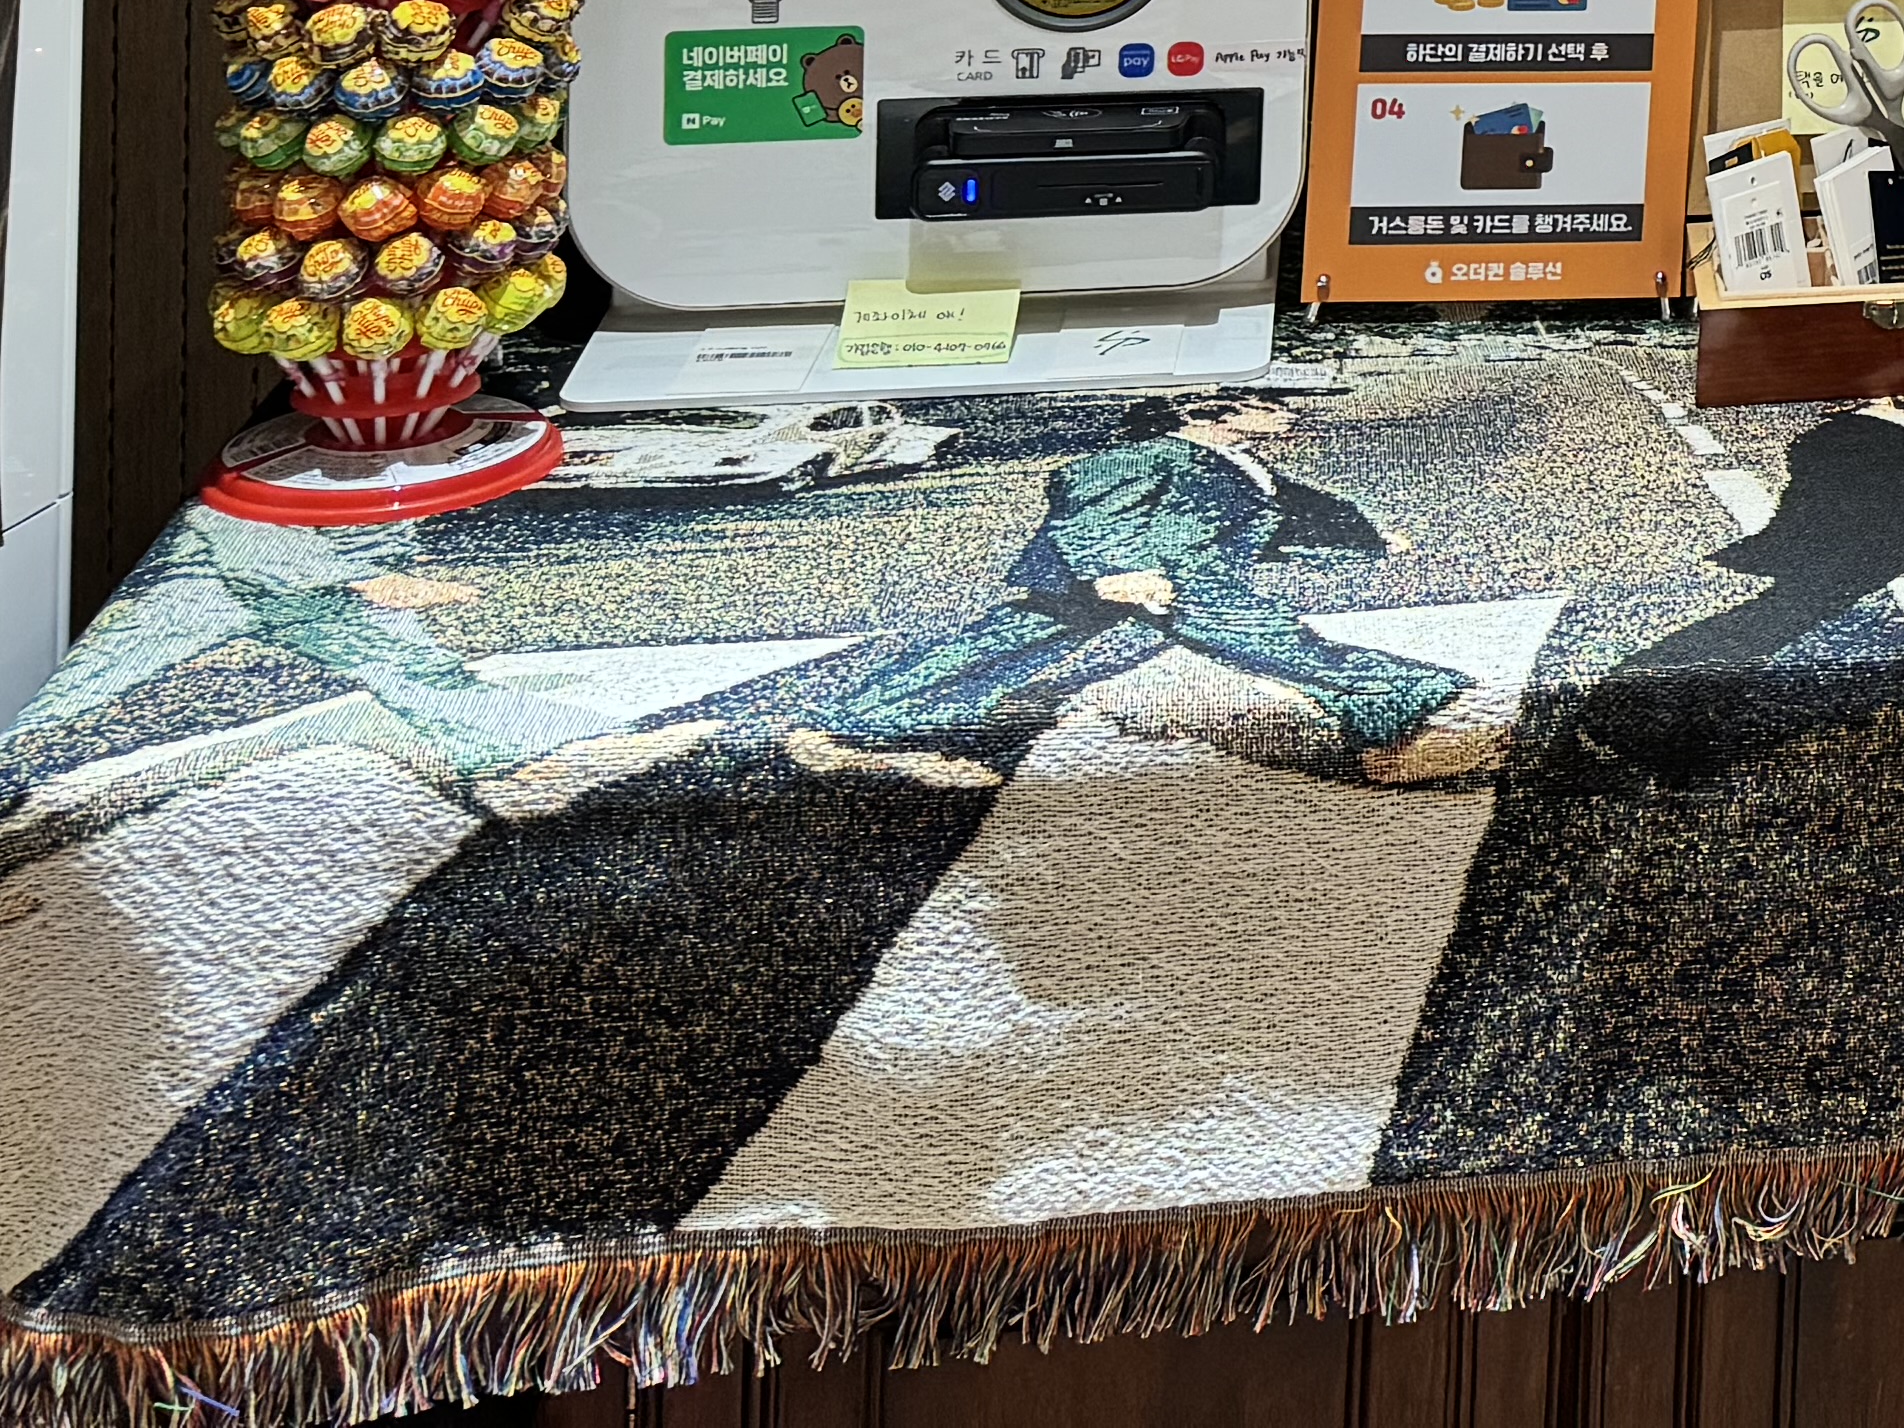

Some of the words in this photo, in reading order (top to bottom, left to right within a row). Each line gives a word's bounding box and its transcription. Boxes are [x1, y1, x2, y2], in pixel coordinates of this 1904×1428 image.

[681, 43, 788, 67] 네이버페이
[954, 49, 1002, 66] 카드
[1123, 55, 1150, 69] pay
[1406, 43, 1463, 63] 하단의
[1468, 43, 1543, 63] 결제하기
[1547, 42, 1586, 62] 선택
[1590, 42, 1609, 62] 후
[682, 67, 789, 91] 결제하세요
[957, 71, 993, 82] CARD
[1371, 97, 1406, 120] 04
[702, 114, 726, 129] Pay
[1369, 215, 1445, 235] 거스름돈
[1450, 214, 1469, 235] 및
[1476, 214, 1530, 234] 카드를
[1534, 213, 1633, 234] 챙겨주세요.
[1450, 261, 1505, 282] 오더퀸
[1509, 260, 1563, 281] 솔루션
